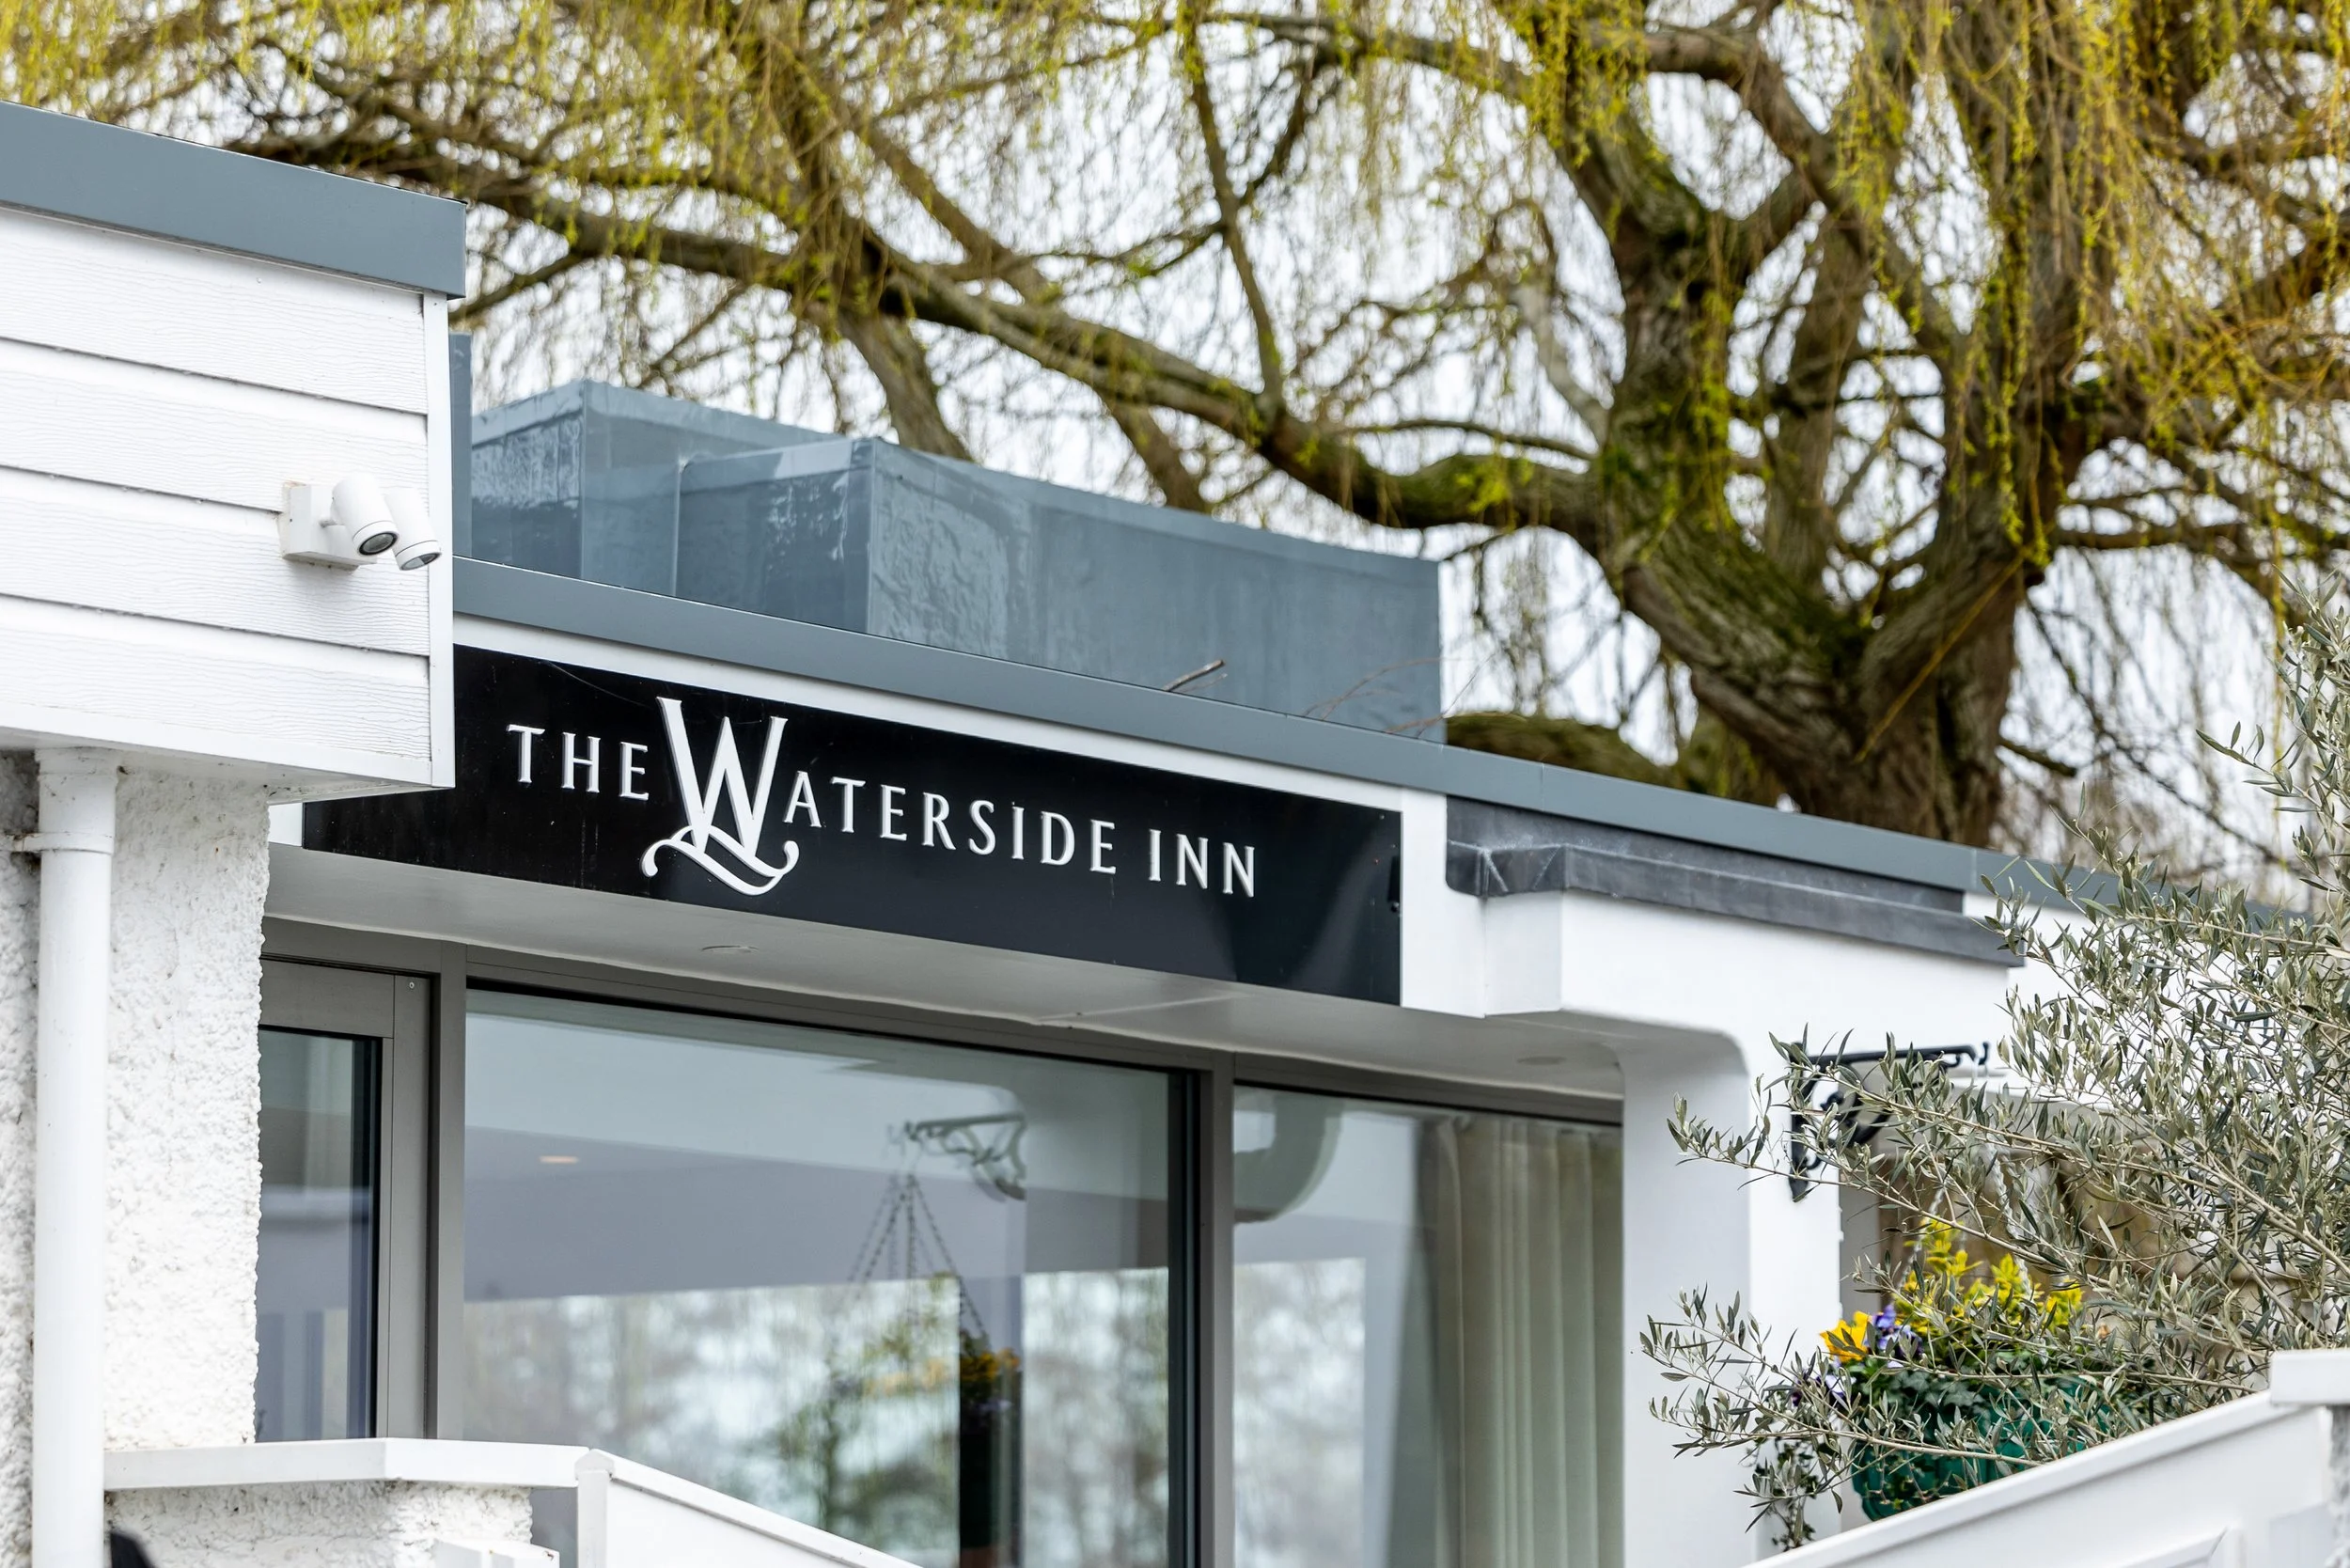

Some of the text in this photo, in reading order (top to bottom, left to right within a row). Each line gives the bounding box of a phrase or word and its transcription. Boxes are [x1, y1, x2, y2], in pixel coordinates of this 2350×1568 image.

[507, 696, 1256, 898] THE WATERSIDE INN
